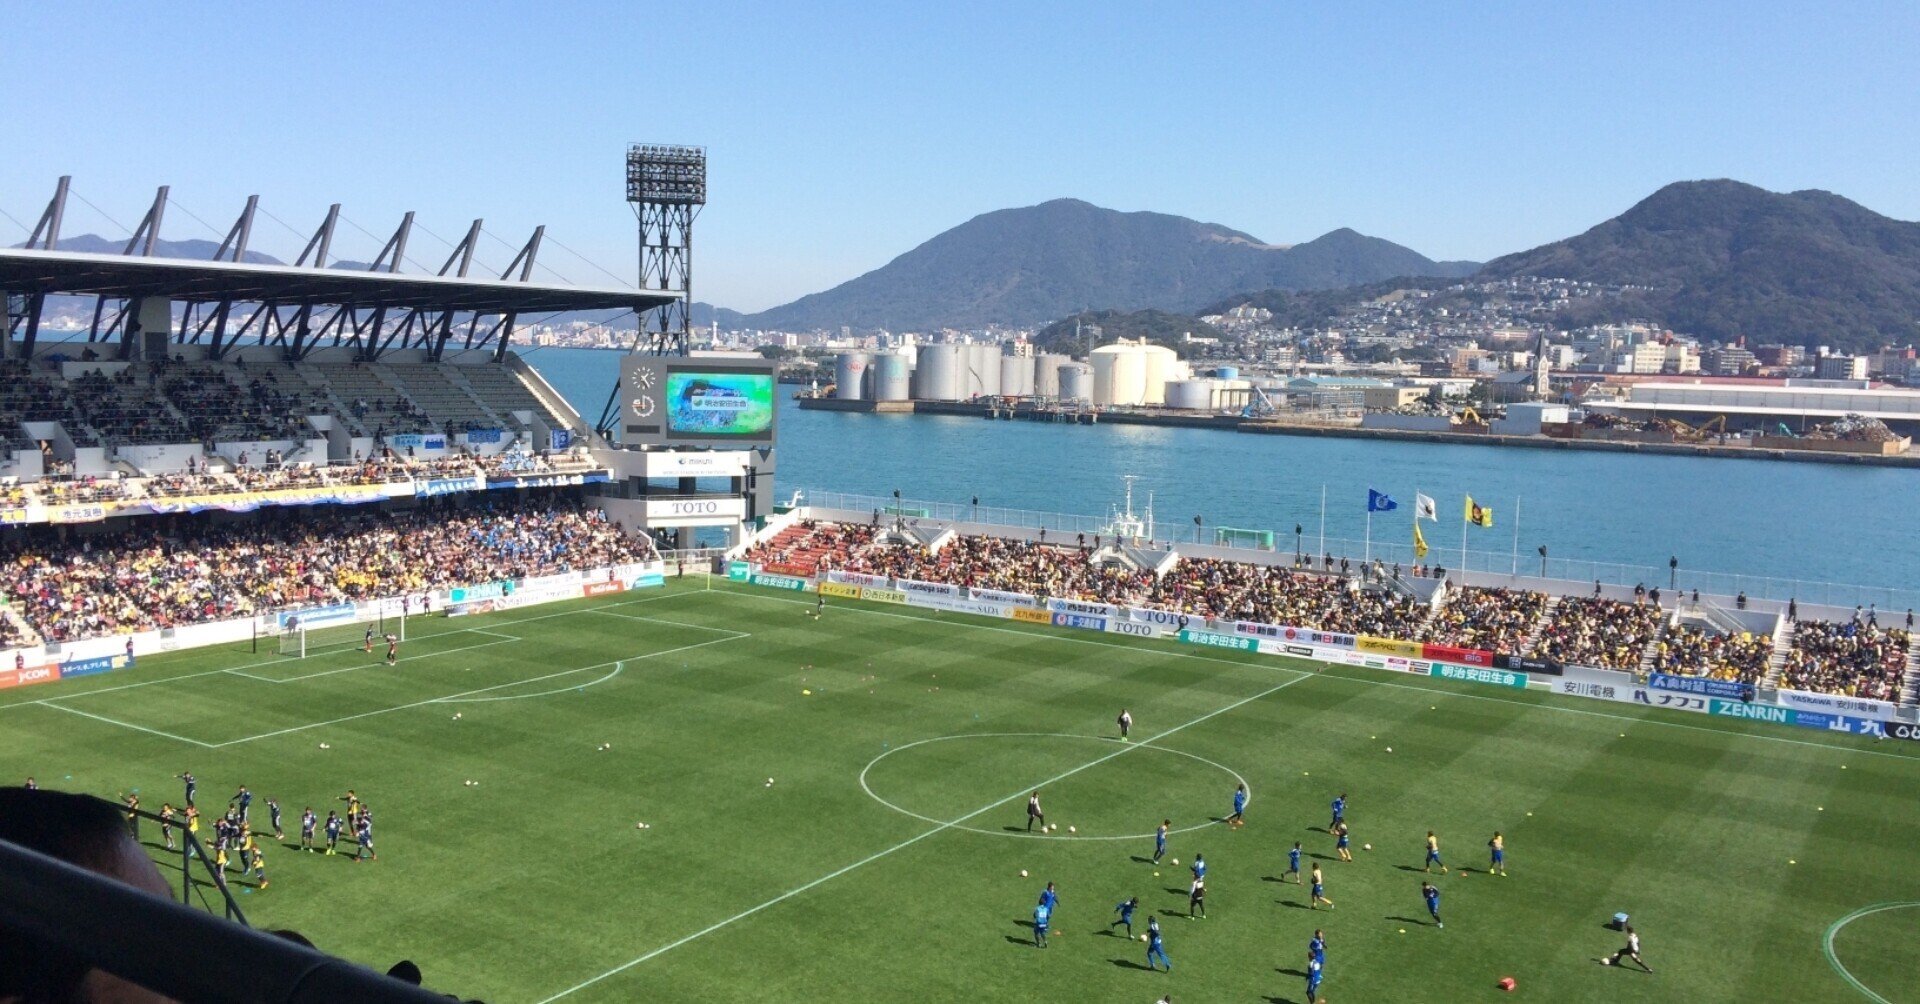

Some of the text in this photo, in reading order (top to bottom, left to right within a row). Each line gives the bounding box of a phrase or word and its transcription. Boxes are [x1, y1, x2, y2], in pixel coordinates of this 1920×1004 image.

[672, 502, 717, 513] TOTO
[977, 604, 999, 615] SADA
[1144, 611, 1189, 626] TOTO
[1115, 622, 1152, 635] TOTO
[1237, 623, 1277, 636] 朝日新聞
[1188, 632, 1250, 649] 明治安田生命
[1312, 633, 1354, 645] 朝日新聞
[1441, 665, 1516, 685] 明治安田生命
[1564, 682, 1615, 698] 安川電機
[1657, 694, 1705, 709] ナフコ
[1791, 694, 1879, 713] YASKAWA 安川電機
[1718, 701, 1786, 722] ZENRIN
[1829, 715, 1881, 735] 山九
